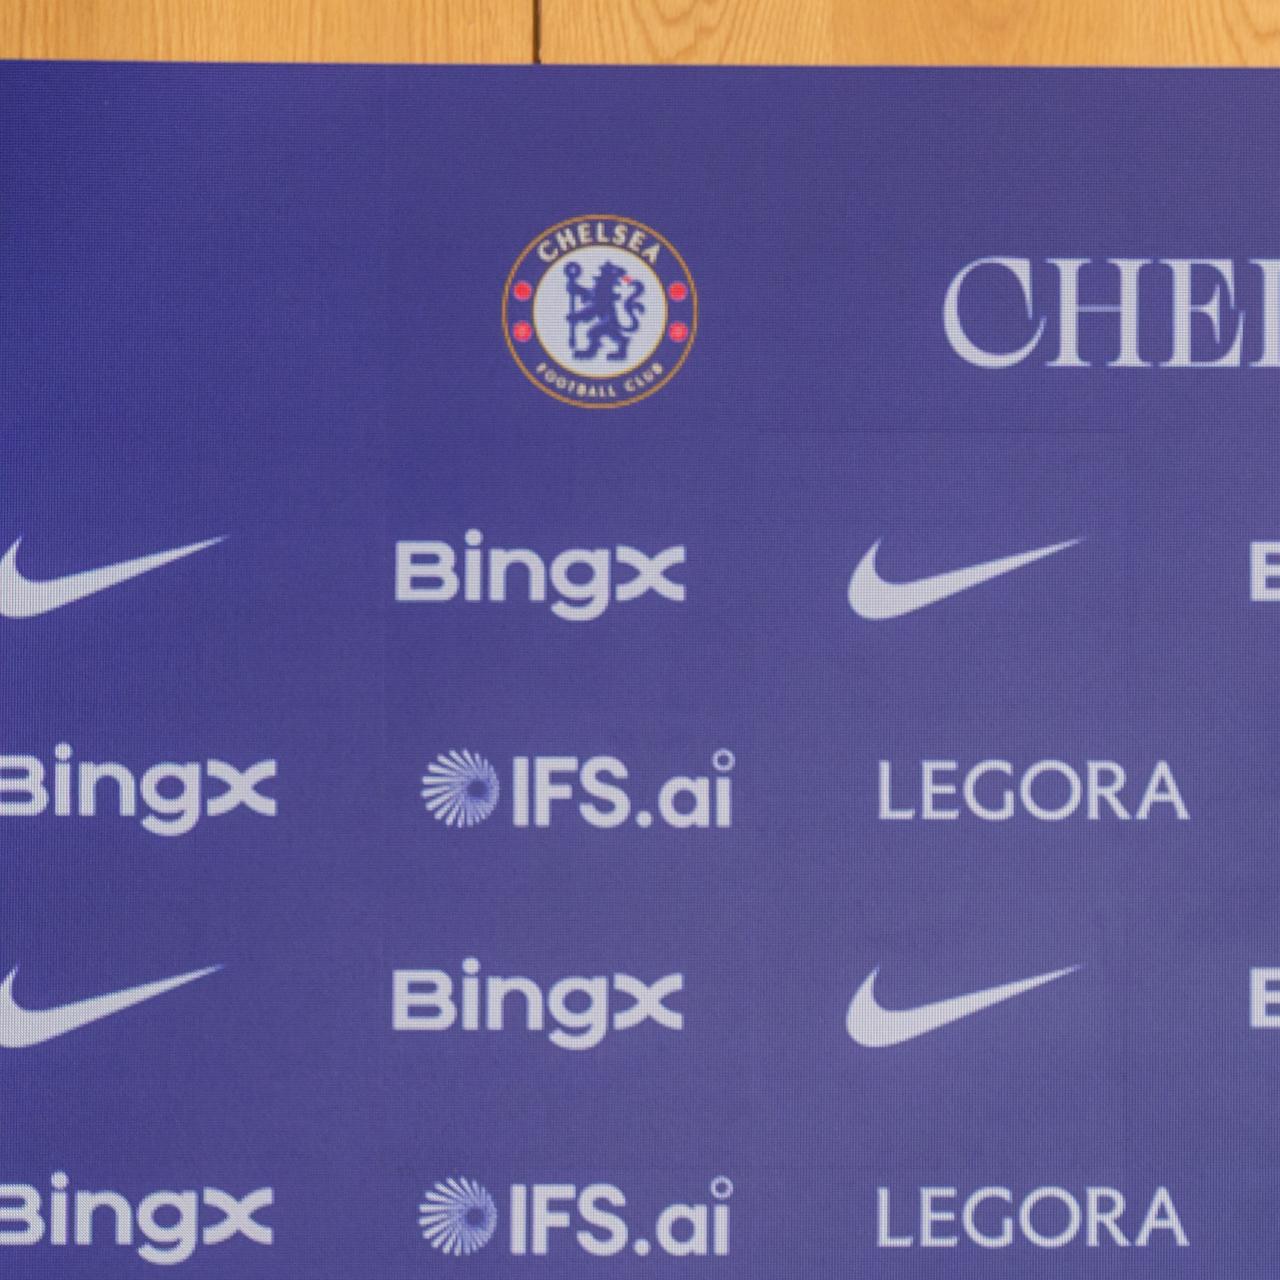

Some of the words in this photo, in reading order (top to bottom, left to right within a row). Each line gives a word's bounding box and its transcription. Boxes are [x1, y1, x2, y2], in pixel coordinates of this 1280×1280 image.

[537, 222, 661, 264] CHELSEA
[536, 362, 616, 398] FOOTBALL
[624, 362, 663, 392] CLUB
[514, 750, 734, 827] IFS.ai
[880, 760, 1189, 820] LEGORA
[511, 1177, 732, 1255] IFS.ai
[878, 1187, 1188, 1247] LEGORA
